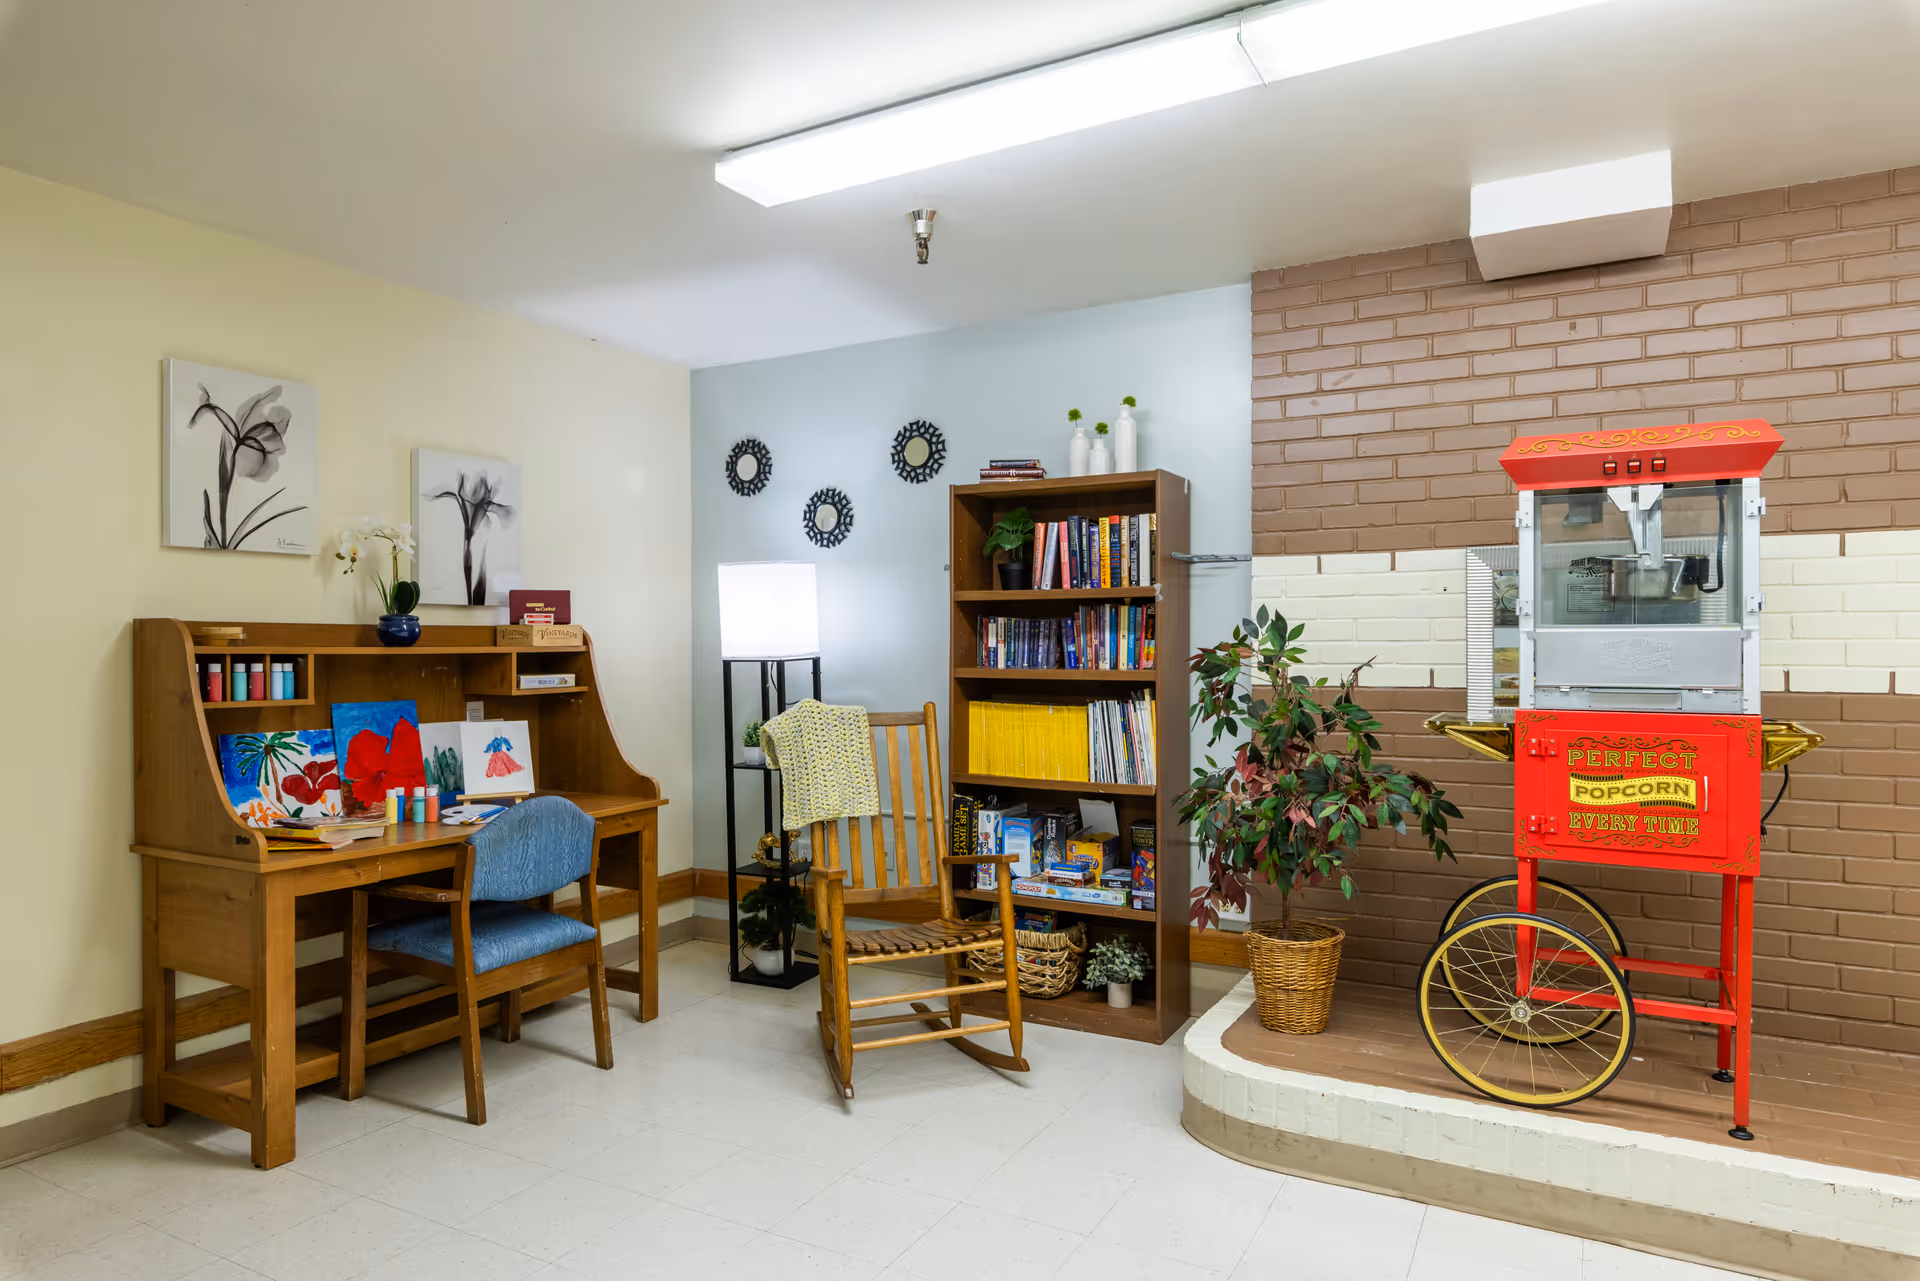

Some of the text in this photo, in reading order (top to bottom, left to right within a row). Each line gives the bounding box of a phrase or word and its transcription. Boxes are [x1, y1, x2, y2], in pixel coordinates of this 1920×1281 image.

[537, 628, 578, 640] VINEYARDS
[1567, 749, 1698, 769] PERFECT
[1575, 782, 1691, 799] POPCORN
[960, 804, 969, 856] GAME SET
[1568, 811, 1699, 835] EVERY TIME
[1015, 884, 1041, 892] MONOPOLY
